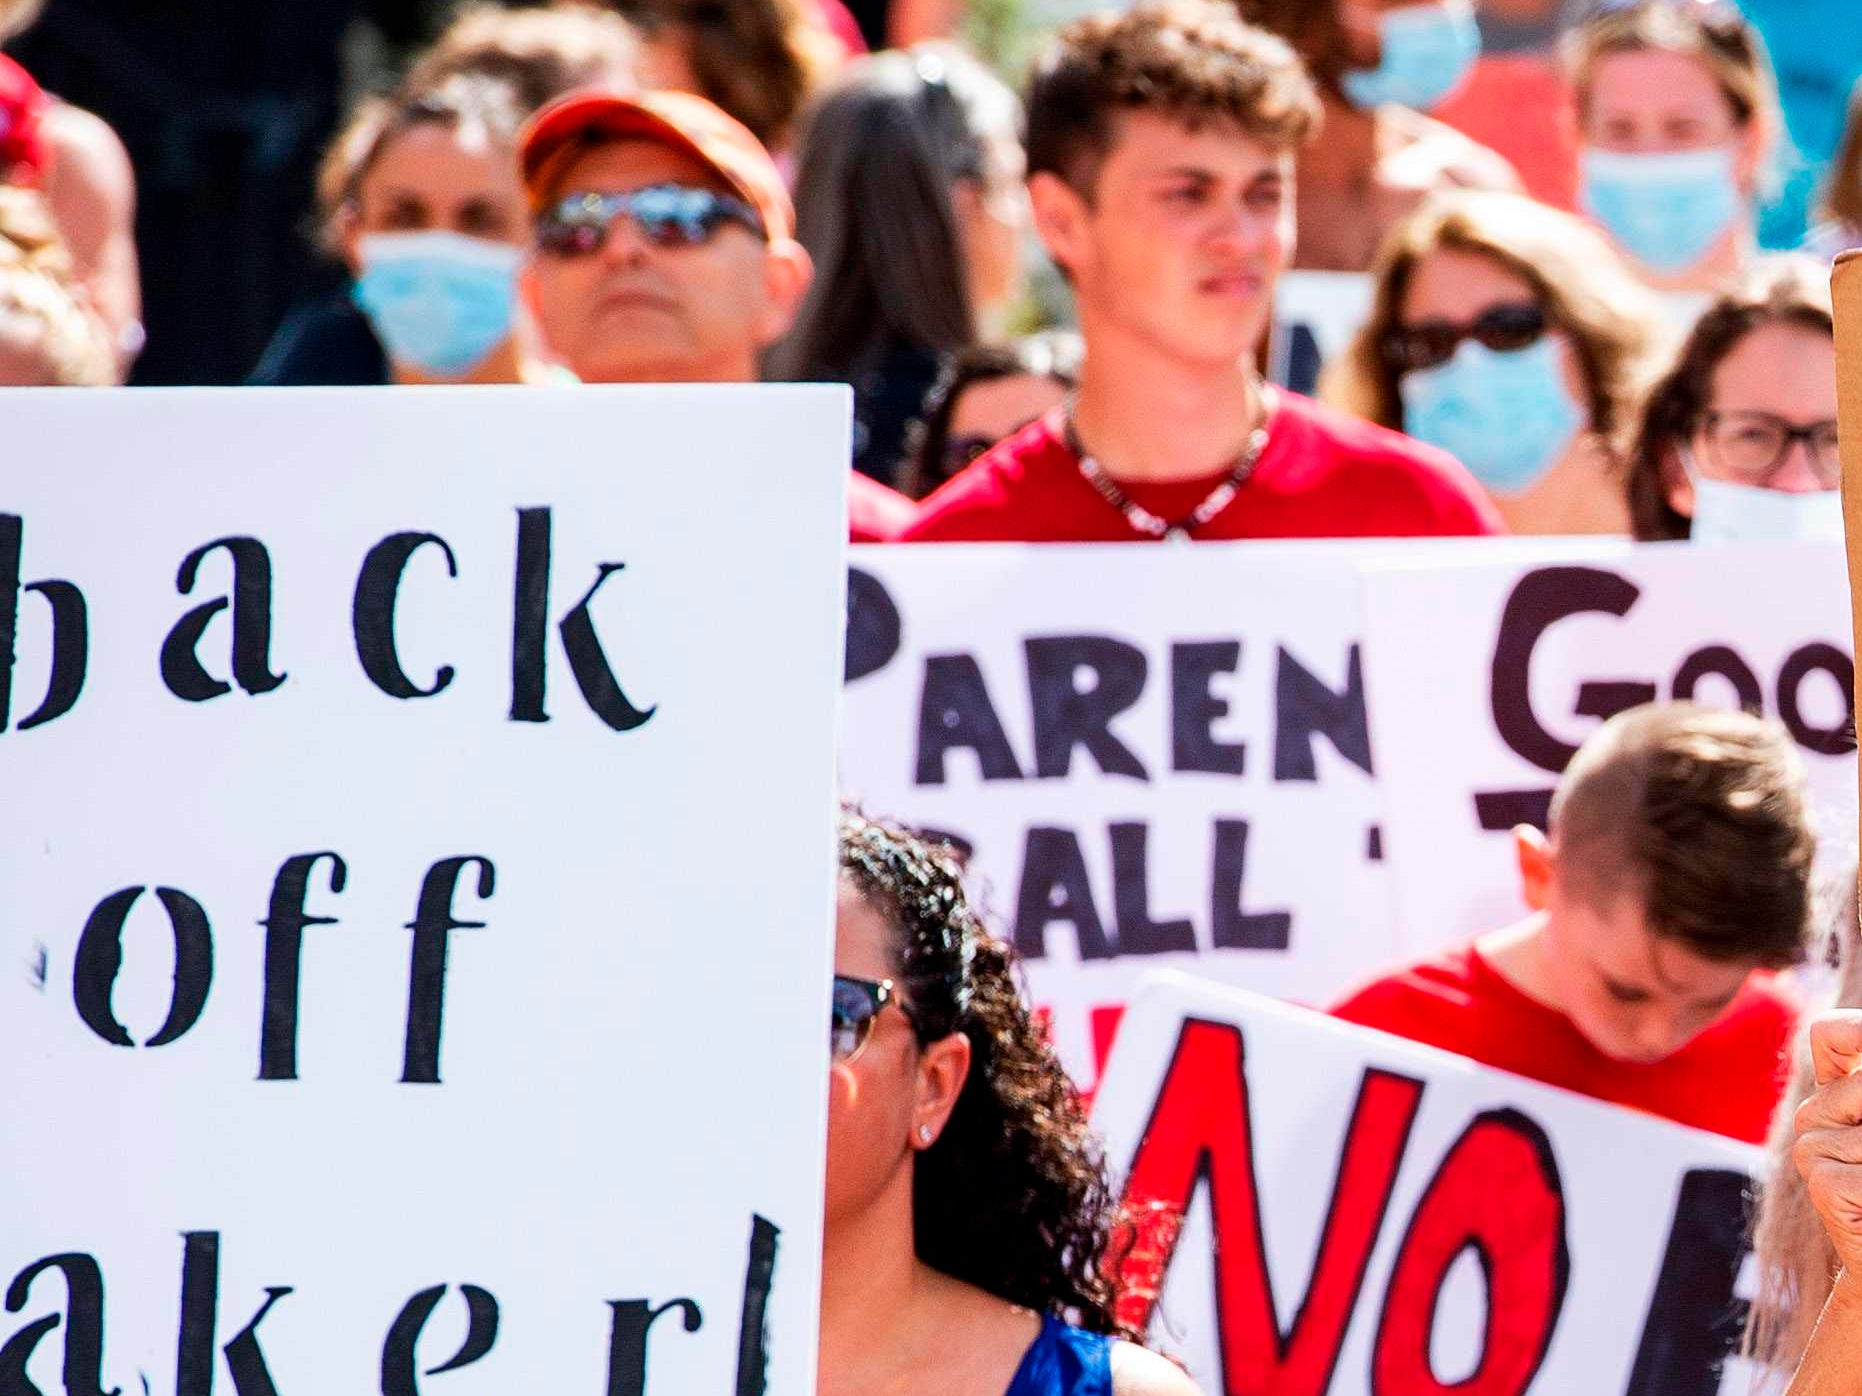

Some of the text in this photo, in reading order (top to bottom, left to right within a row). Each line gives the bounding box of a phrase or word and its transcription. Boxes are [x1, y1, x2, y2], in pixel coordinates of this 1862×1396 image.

[0, 505, 657, 733] back
[73, 850, 497, 1084] off
[921, 820, 1292, 960] ALL
